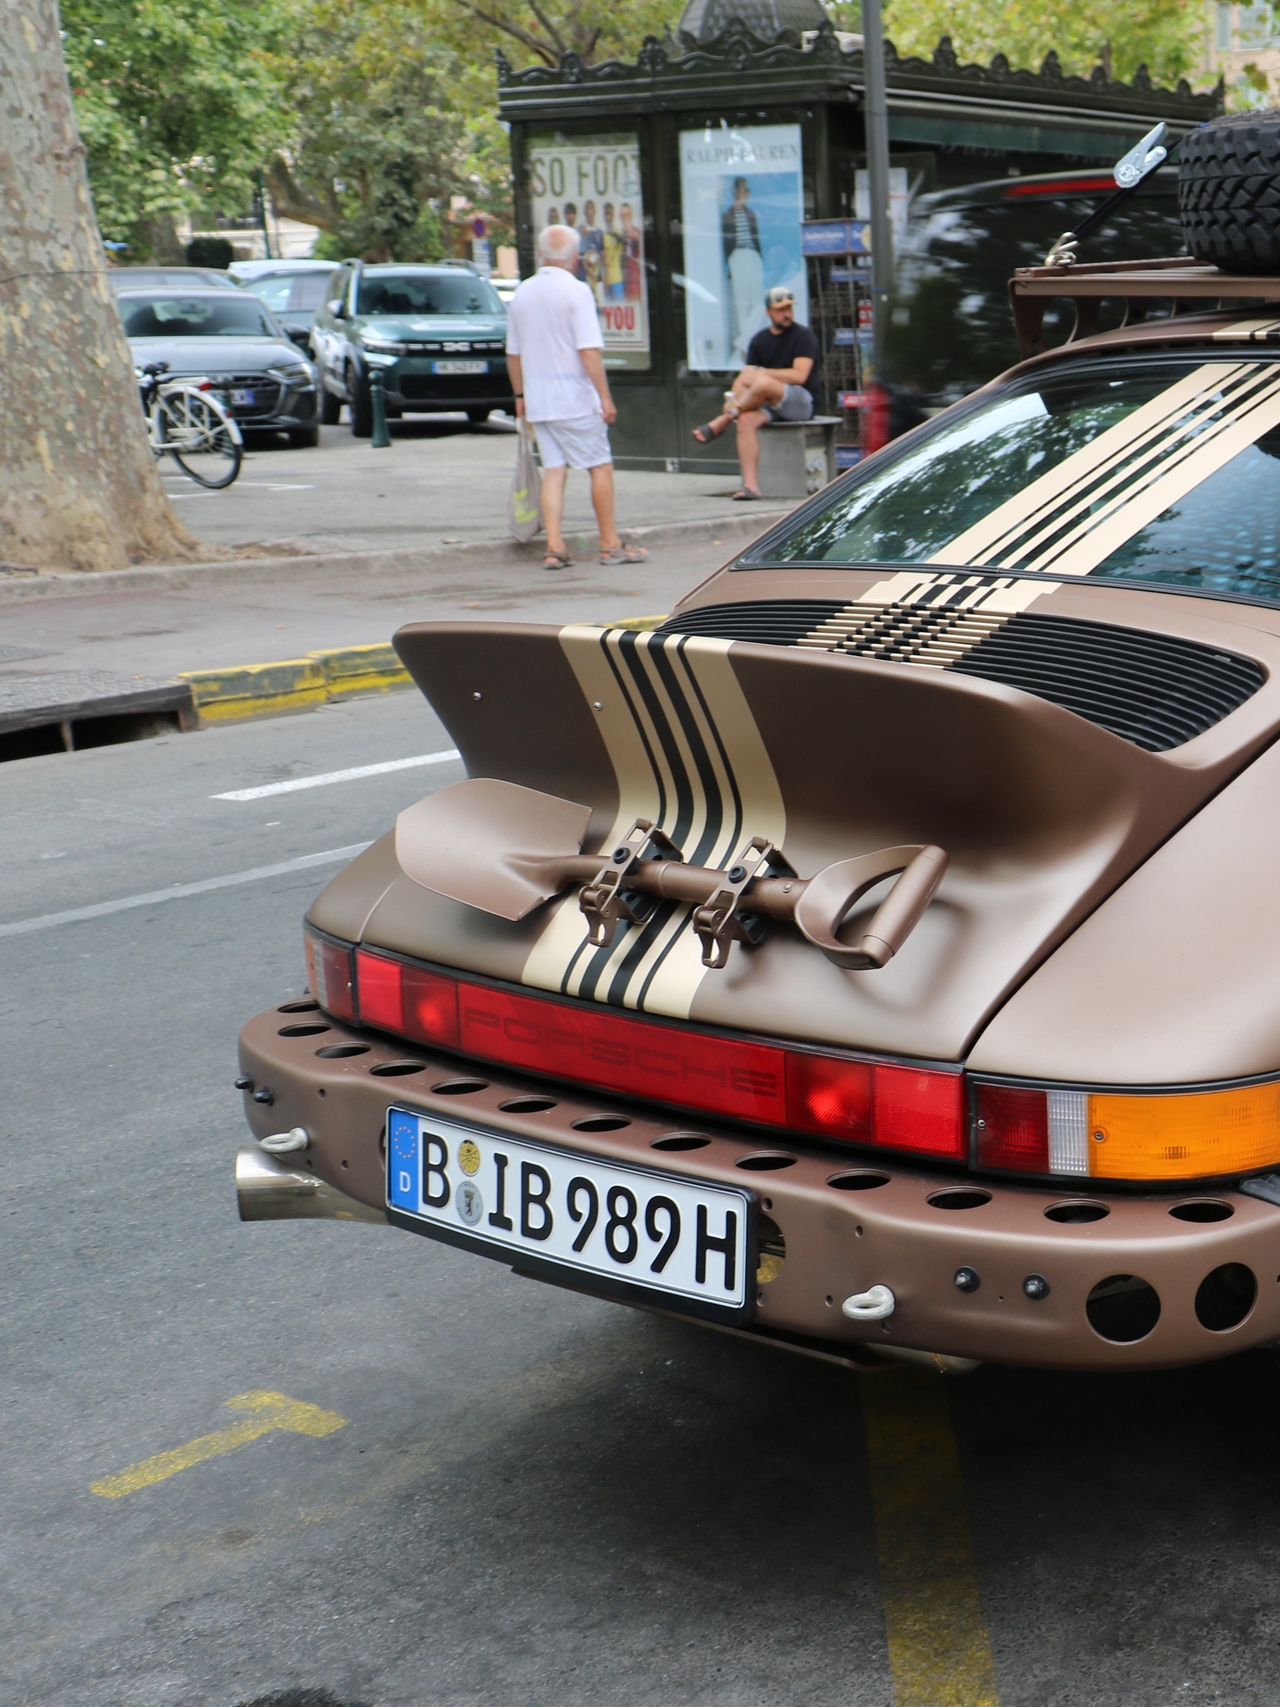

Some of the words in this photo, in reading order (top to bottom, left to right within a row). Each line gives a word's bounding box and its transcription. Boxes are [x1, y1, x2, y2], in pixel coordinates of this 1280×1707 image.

[531, 155, 565, 198] SO
[603, 305, 635, 330] YOU
[464, 1007, 778, 1098] PORSCHE
[400, 1171, 411, 1193] D
